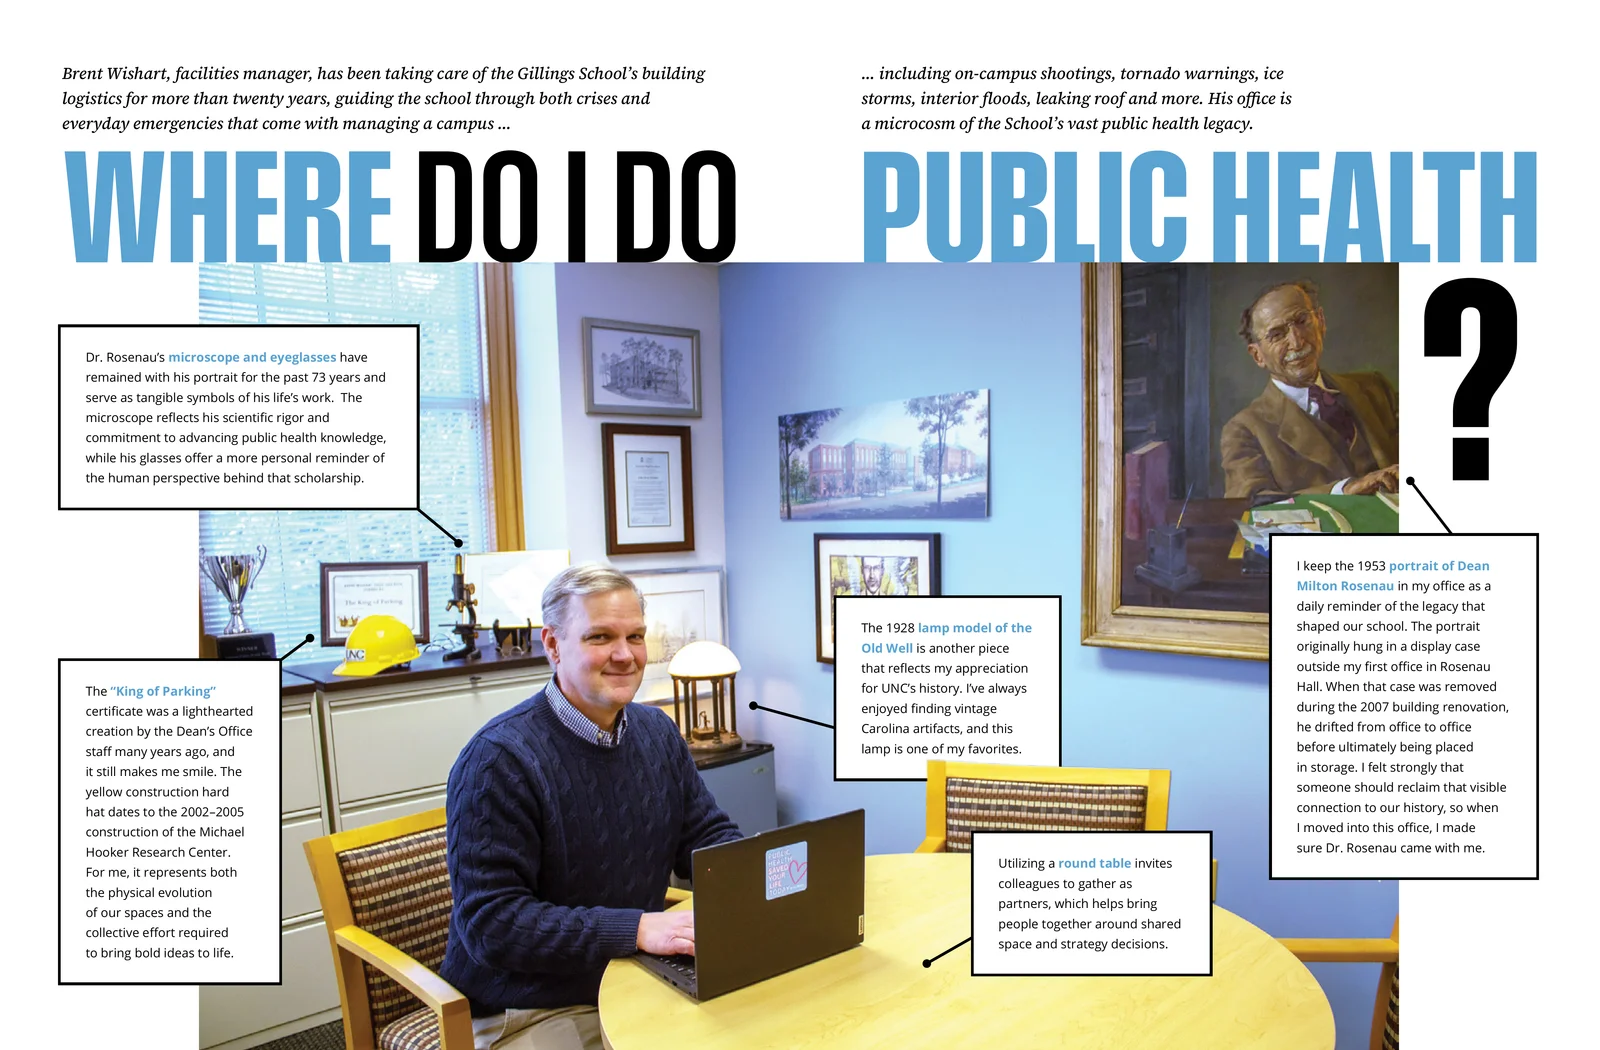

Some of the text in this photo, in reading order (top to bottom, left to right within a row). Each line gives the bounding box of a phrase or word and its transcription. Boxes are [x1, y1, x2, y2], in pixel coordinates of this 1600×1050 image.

[768, 864, 789, 875] SAVED
[768, 872, 785, 882] YOUR
[769, 880, 782, 890] LIFE
